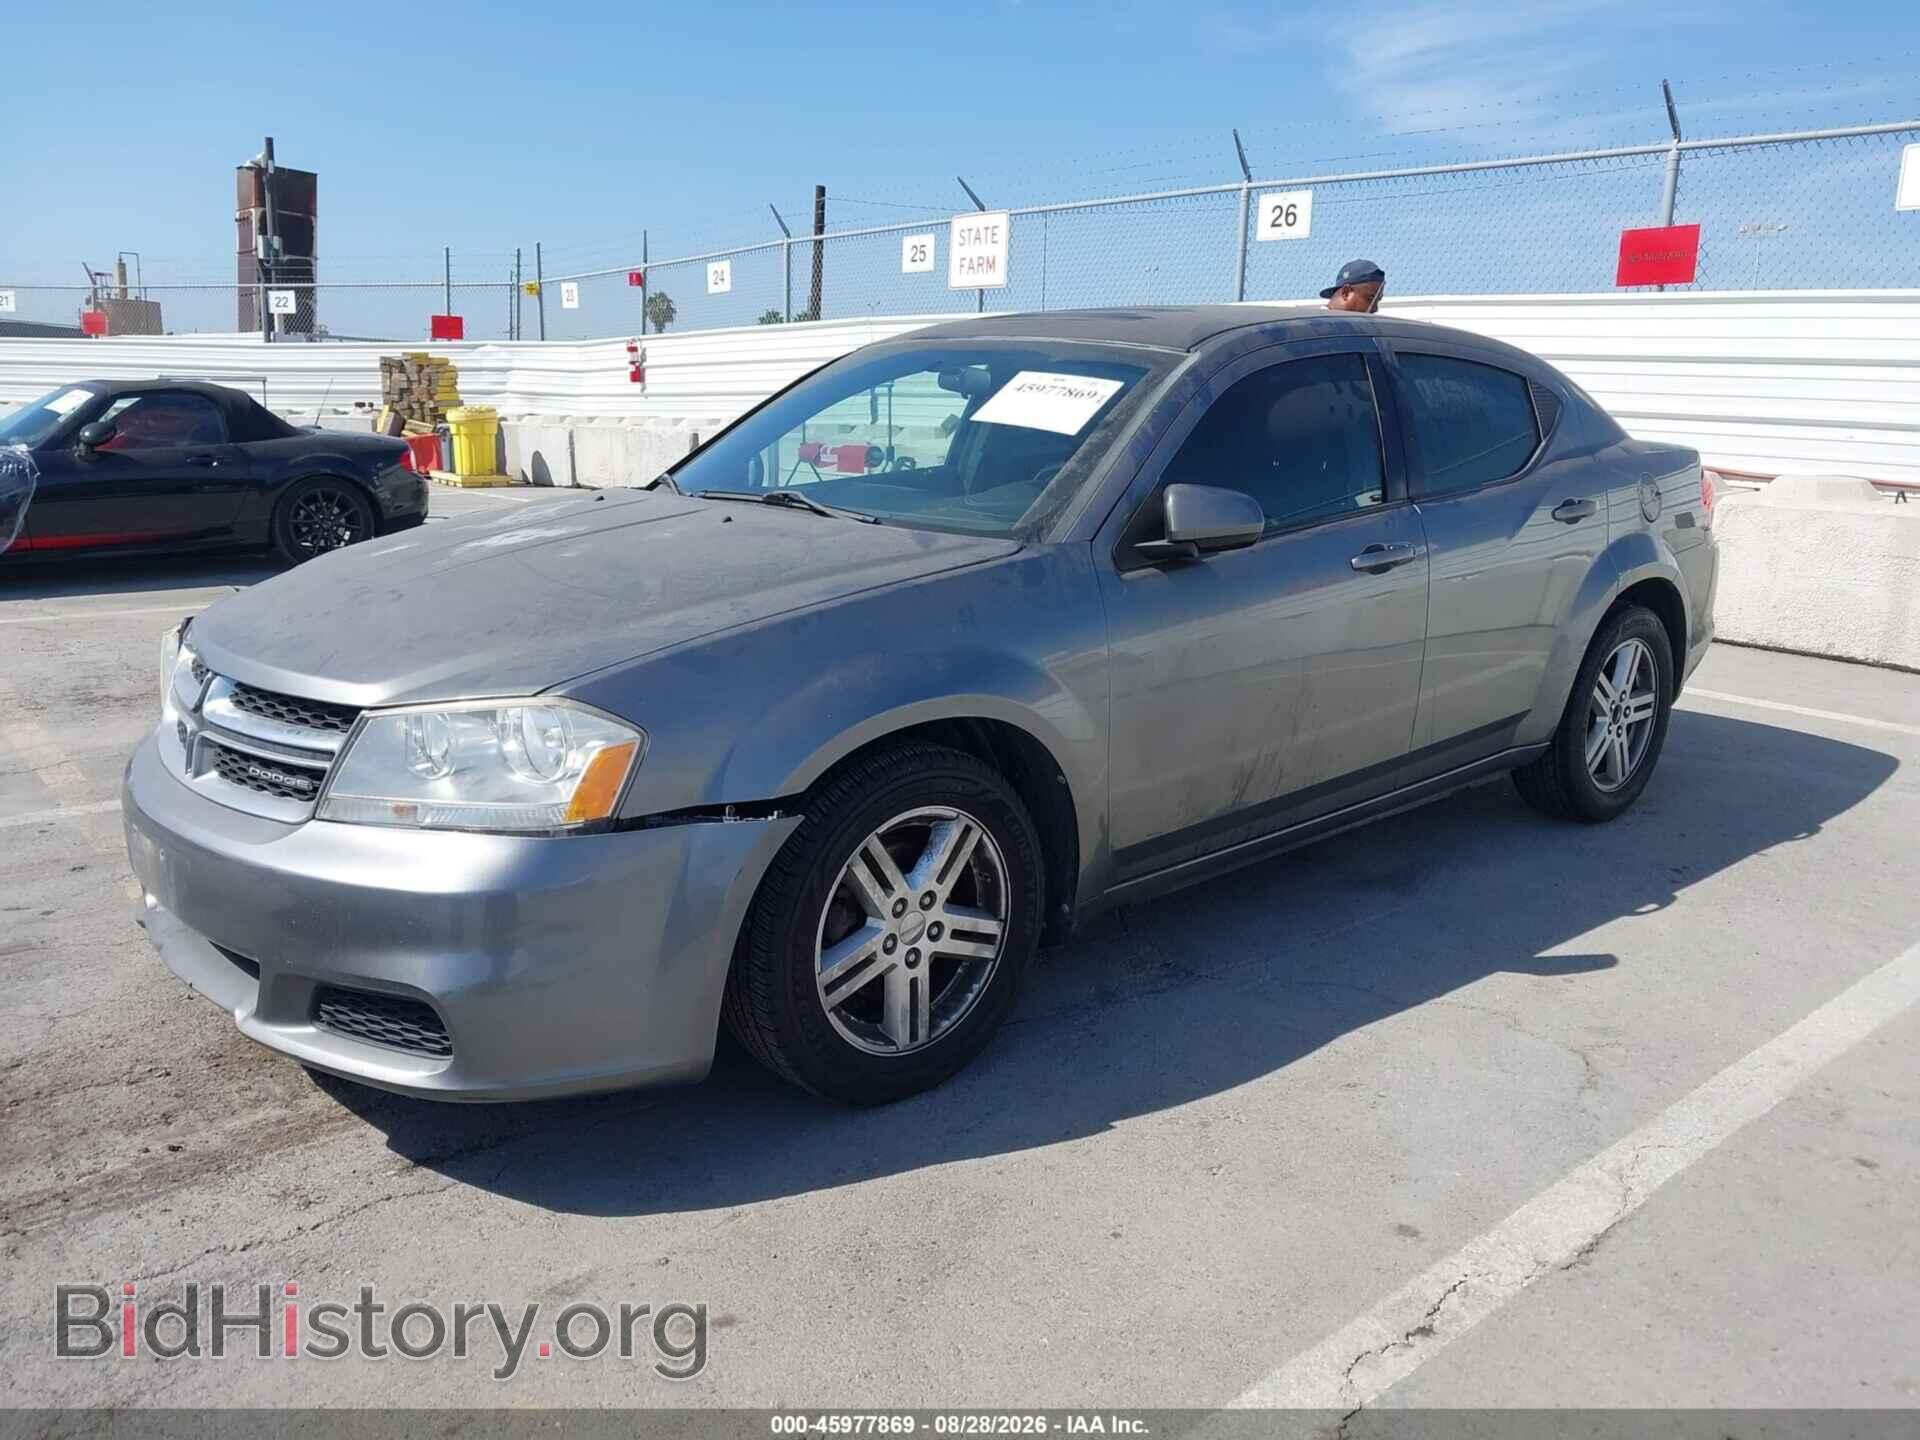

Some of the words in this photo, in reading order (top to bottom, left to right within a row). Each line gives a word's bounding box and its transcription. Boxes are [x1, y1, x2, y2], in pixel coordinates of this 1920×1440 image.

[1270, 203, 1297, 228] 26
[958, 225, 1000, 247] STATE
[910, 244, 927, 263] 25
[959, 255, 997, 275] FARM
[712, 269, 726, 286] 24
[274, 296, 289, 308] 22
[248, 766, 313, 792] DODGE
